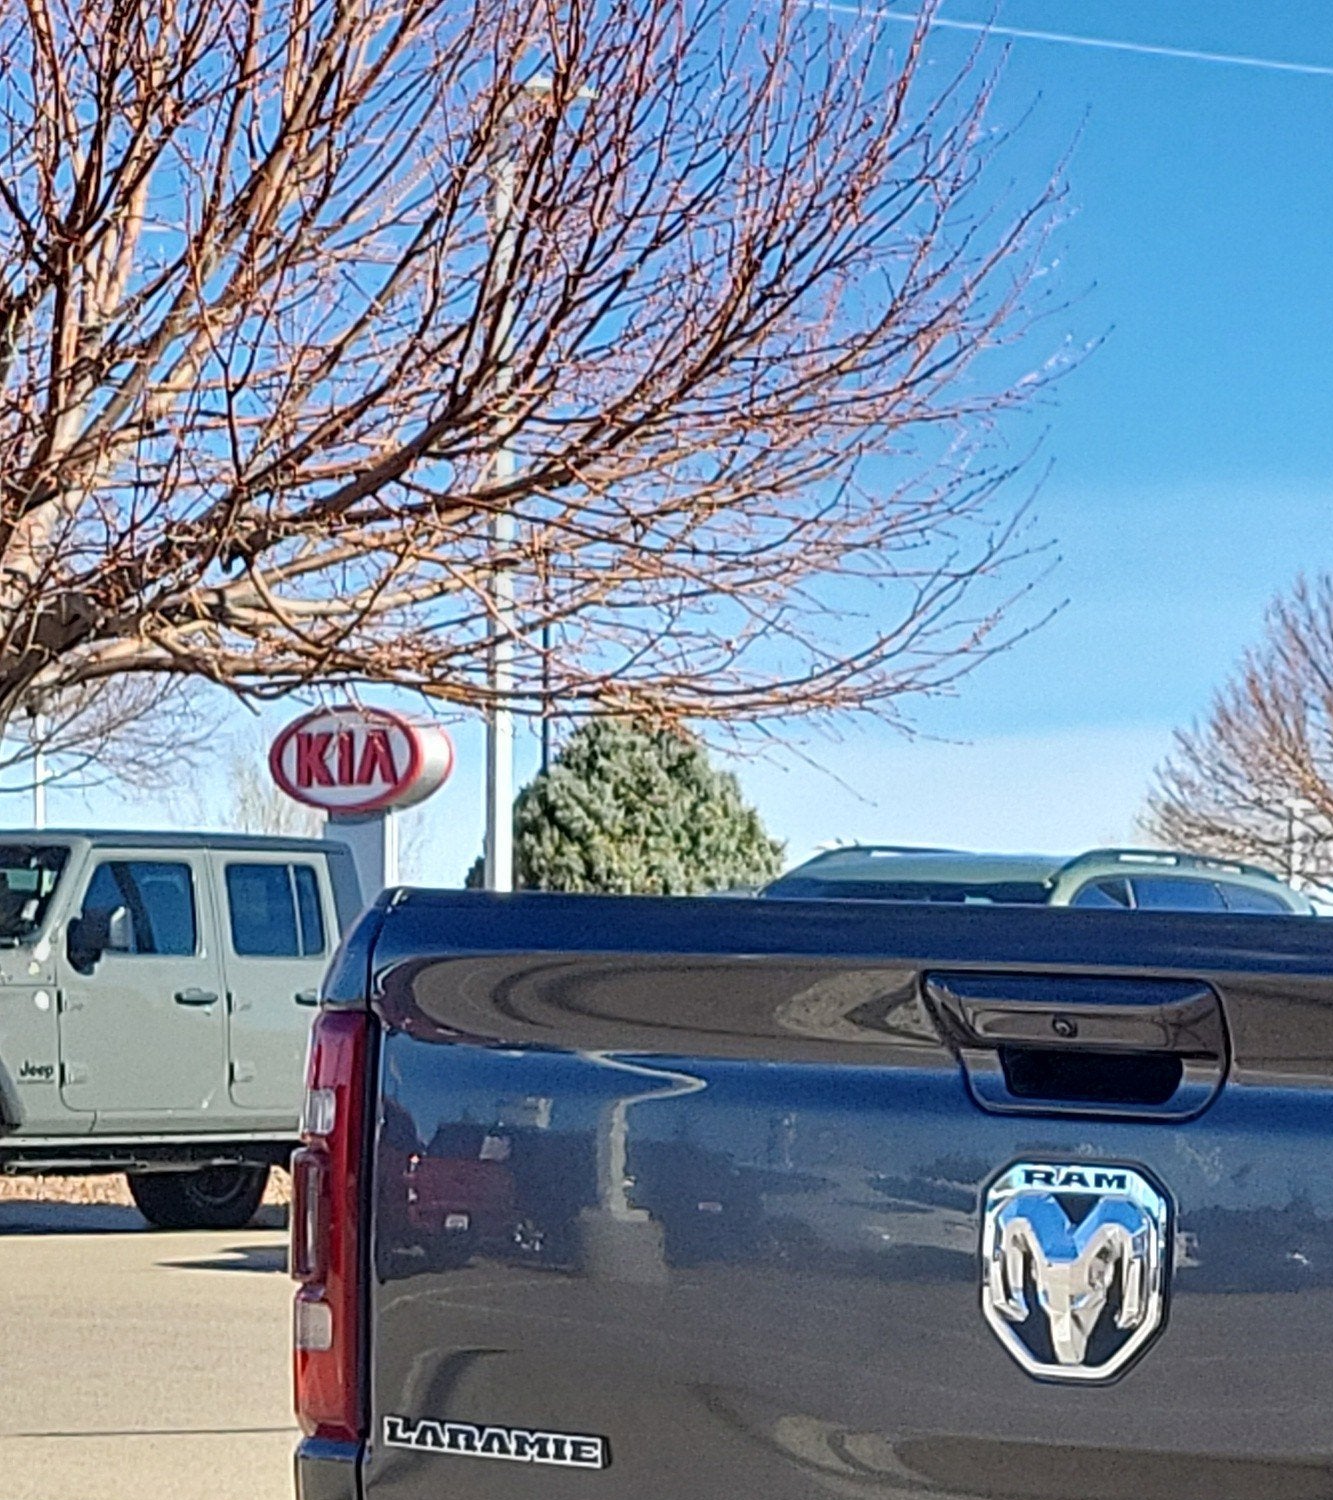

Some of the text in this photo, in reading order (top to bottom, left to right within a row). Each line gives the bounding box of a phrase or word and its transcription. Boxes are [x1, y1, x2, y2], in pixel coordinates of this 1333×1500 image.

[296, 728, 399, 788] KIA
[19, 1059, 54, 1079] Jeep
[1023, 1168, 1127, 1190] RAM
[384, 1416, 609, 1469] LARAMIE
